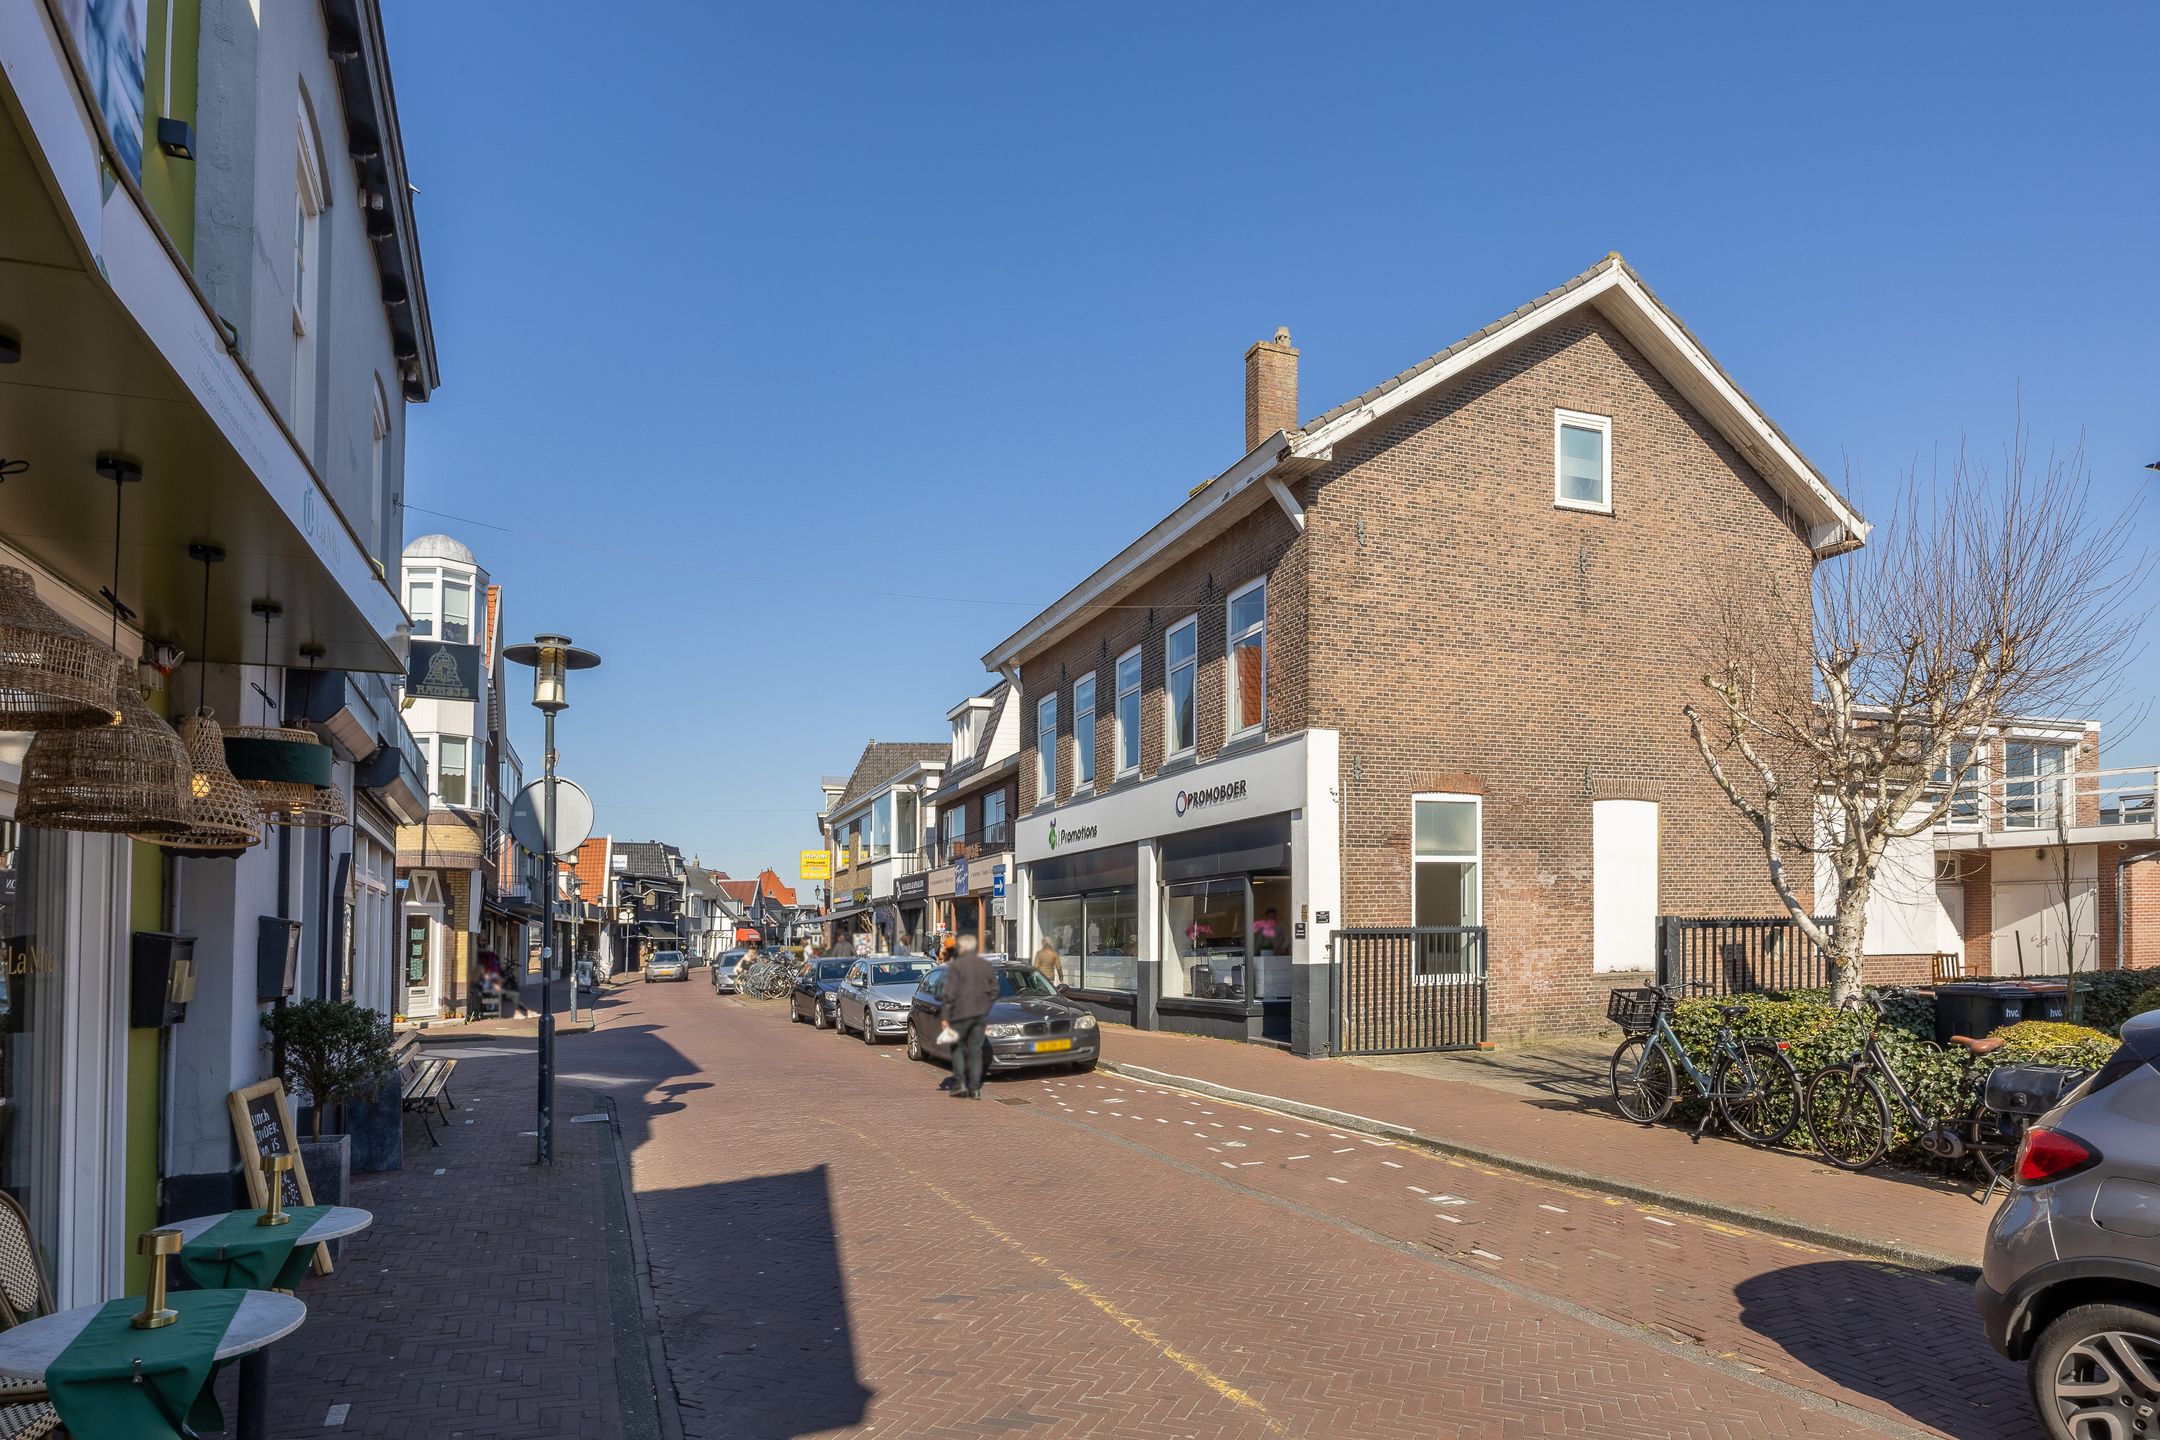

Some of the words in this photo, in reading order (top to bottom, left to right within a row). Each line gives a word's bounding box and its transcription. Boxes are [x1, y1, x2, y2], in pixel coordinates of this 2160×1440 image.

[1187, 779, 1247, 810] PROMOBOER
[1060, 824, 1098, 845] Promotions
[8, 945, 26, 975] La
[27, 944, 56, 974] Mia
[251, 1108, 270, 1128] unch
